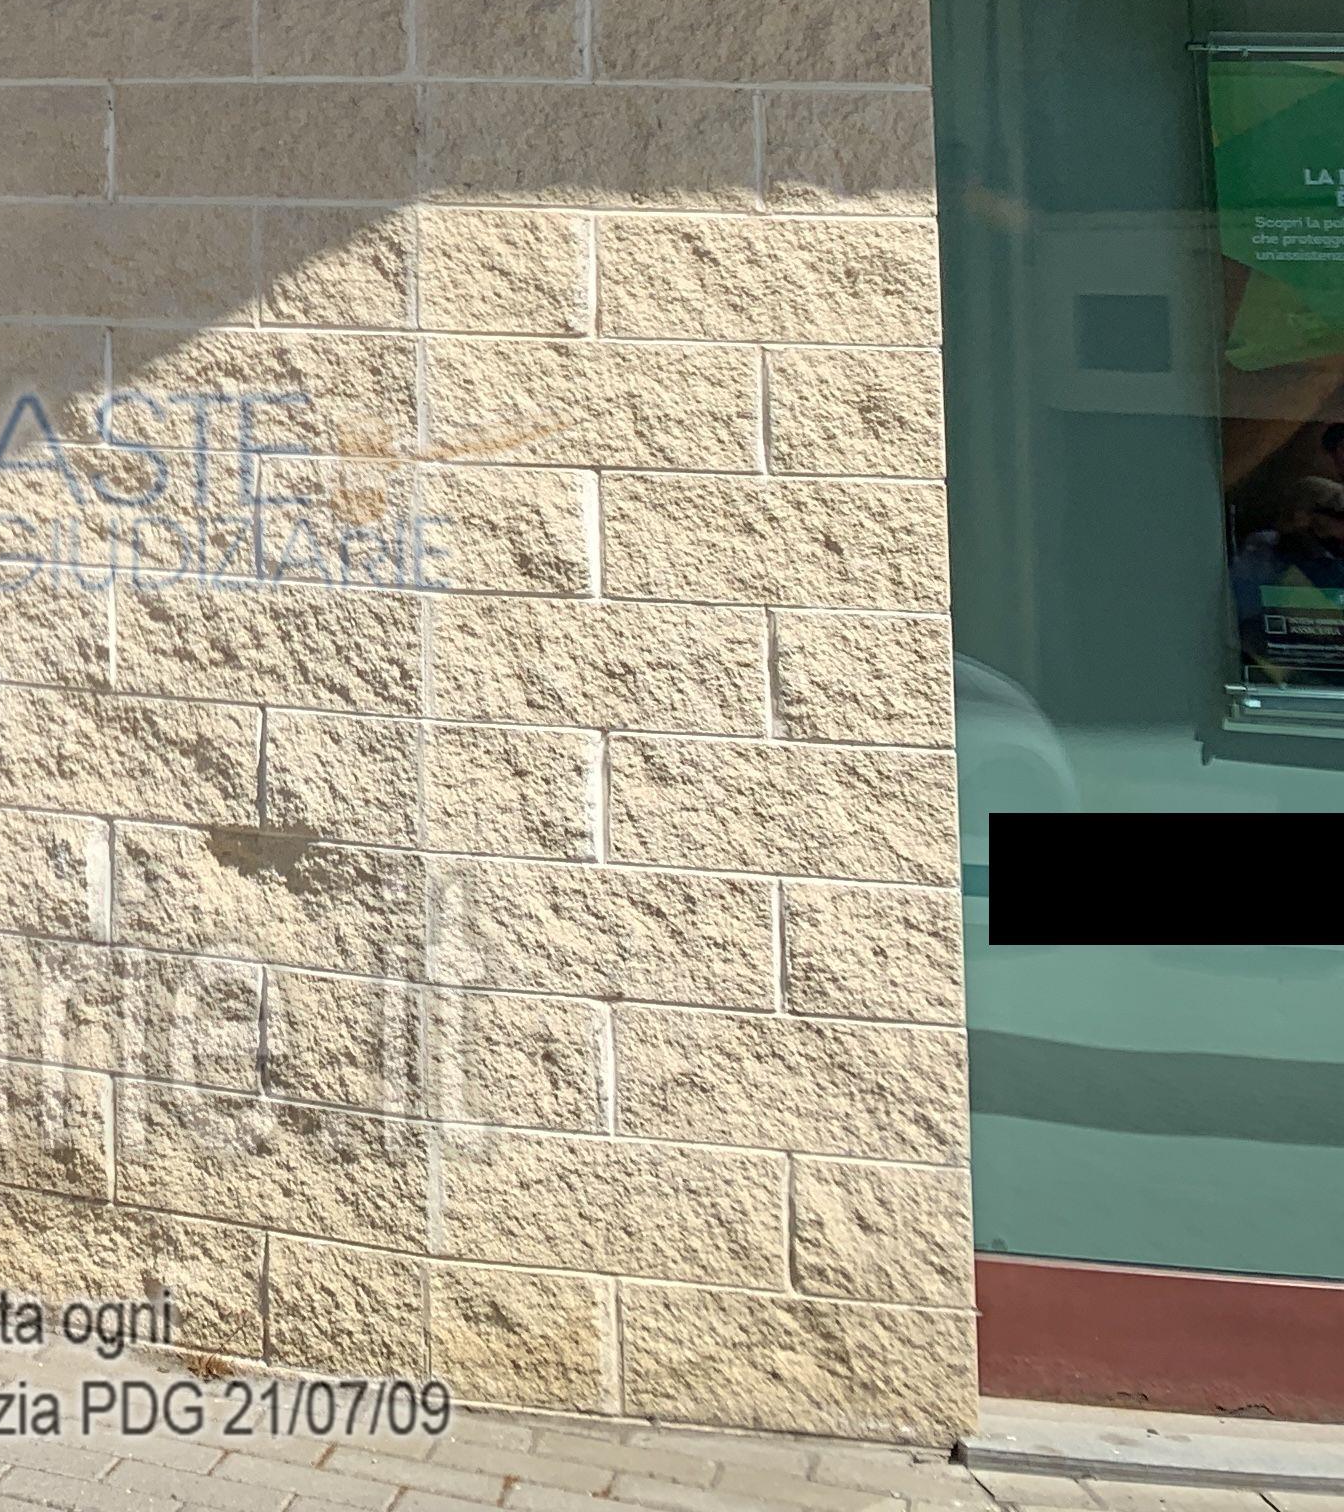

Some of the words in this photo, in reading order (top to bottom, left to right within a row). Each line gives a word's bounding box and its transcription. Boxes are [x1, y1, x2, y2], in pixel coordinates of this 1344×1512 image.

[1304, 168, 1334, 185] LA
[1254, 216, 1302, 231] Scopri
[1306, 217, 1320, 229] la
[1252, 233, 1279, 245] che
